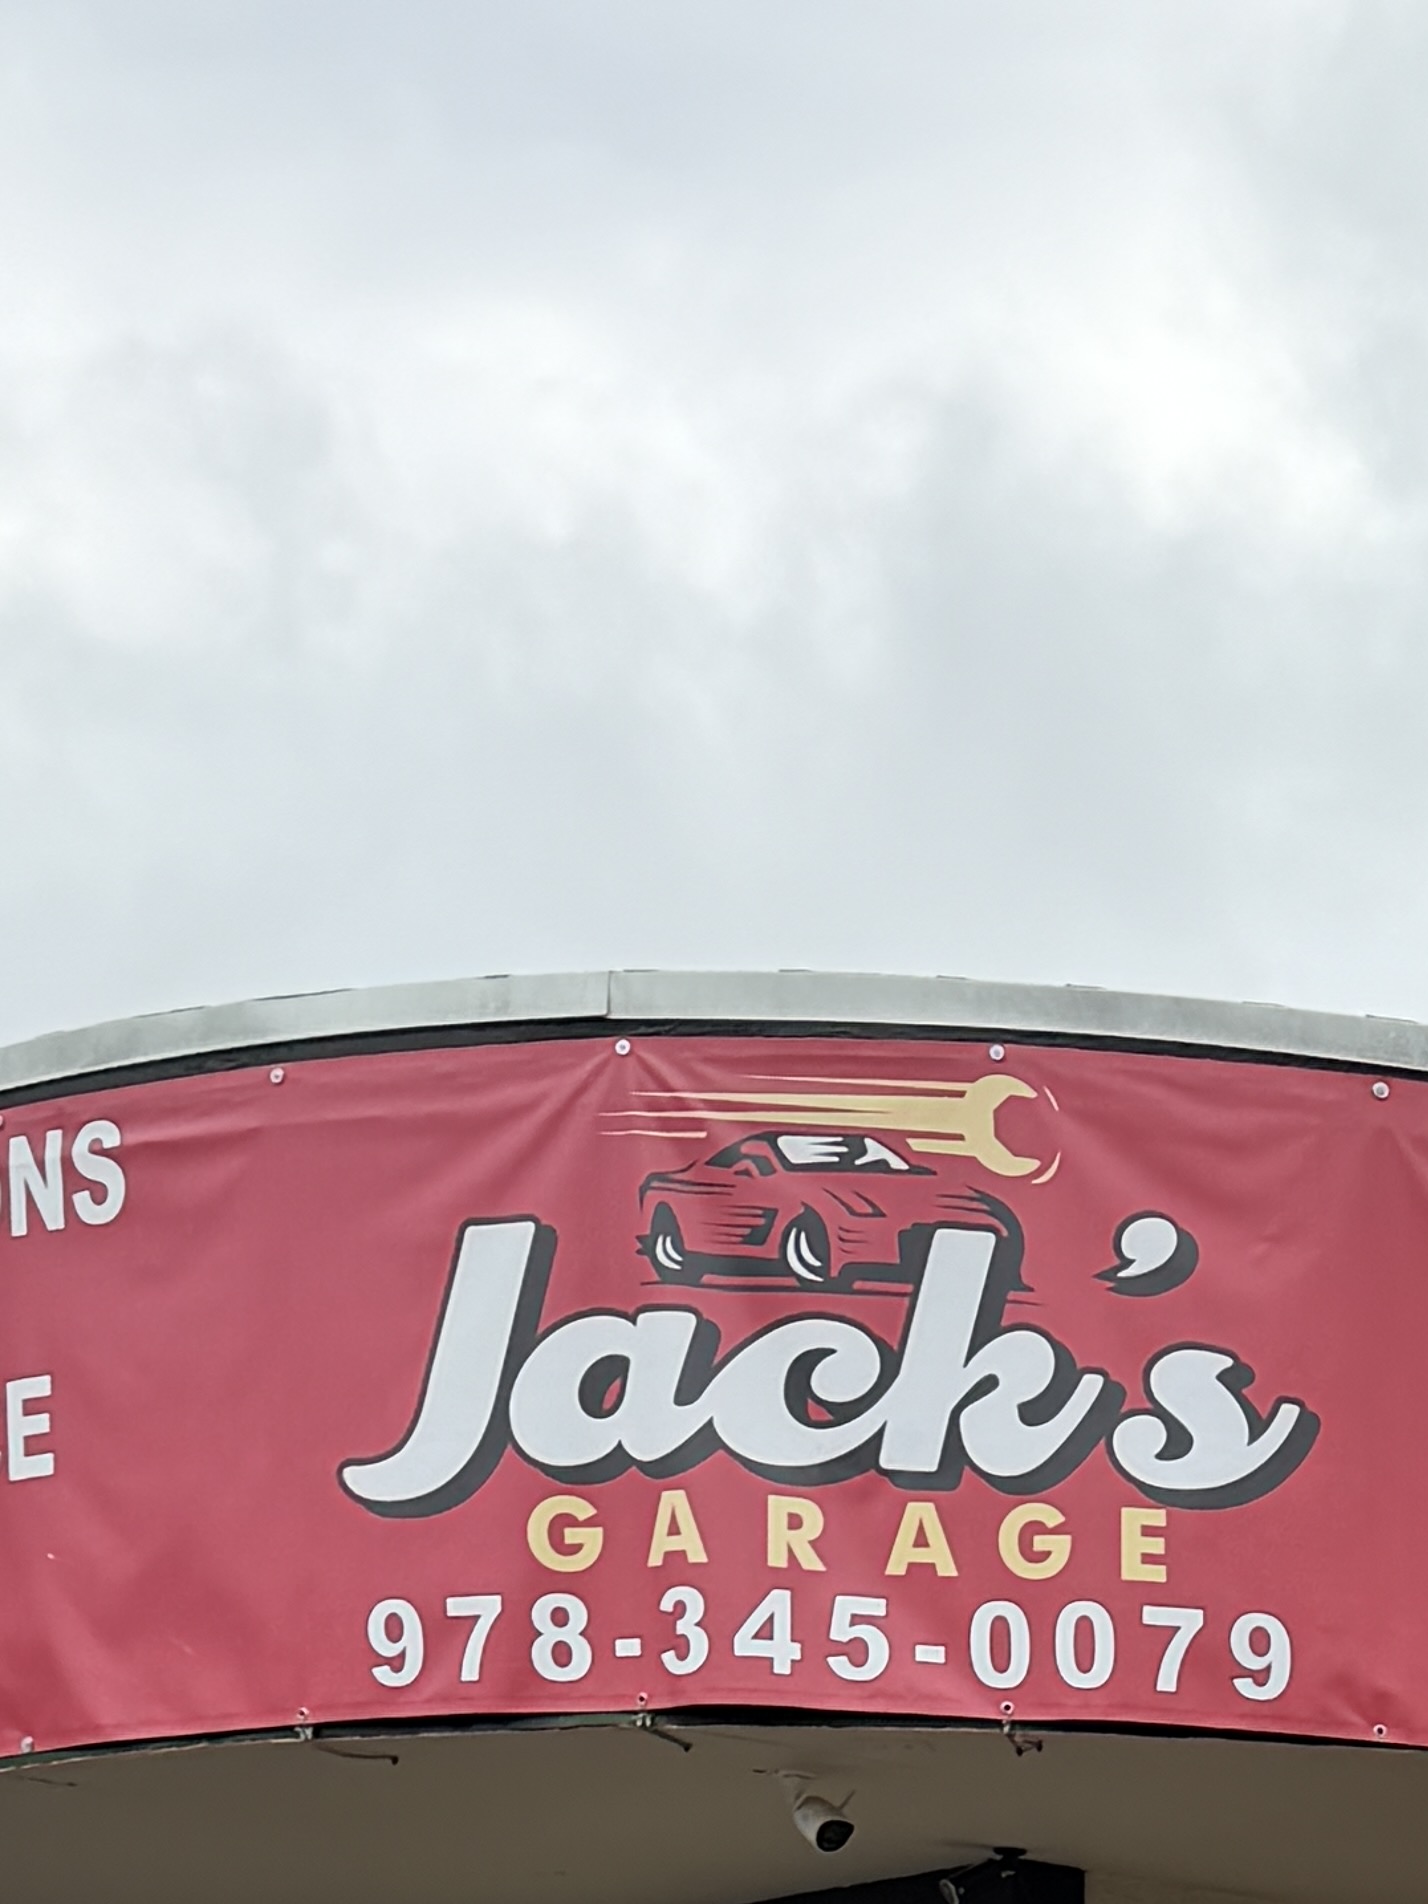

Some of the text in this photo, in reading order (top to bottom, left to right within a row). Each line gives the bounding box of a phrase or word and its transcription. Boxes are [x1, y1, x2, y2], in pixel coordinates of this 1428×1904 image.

[0, 1120, 126, 1237] NS
[339, 1212, 1320, 1517] Jack's
[0, 1374, 55, 1482] E
[528, 1490, 1168, 1583] GARAGE
[366, 1587, 1293, 1702] 978-345-0079
